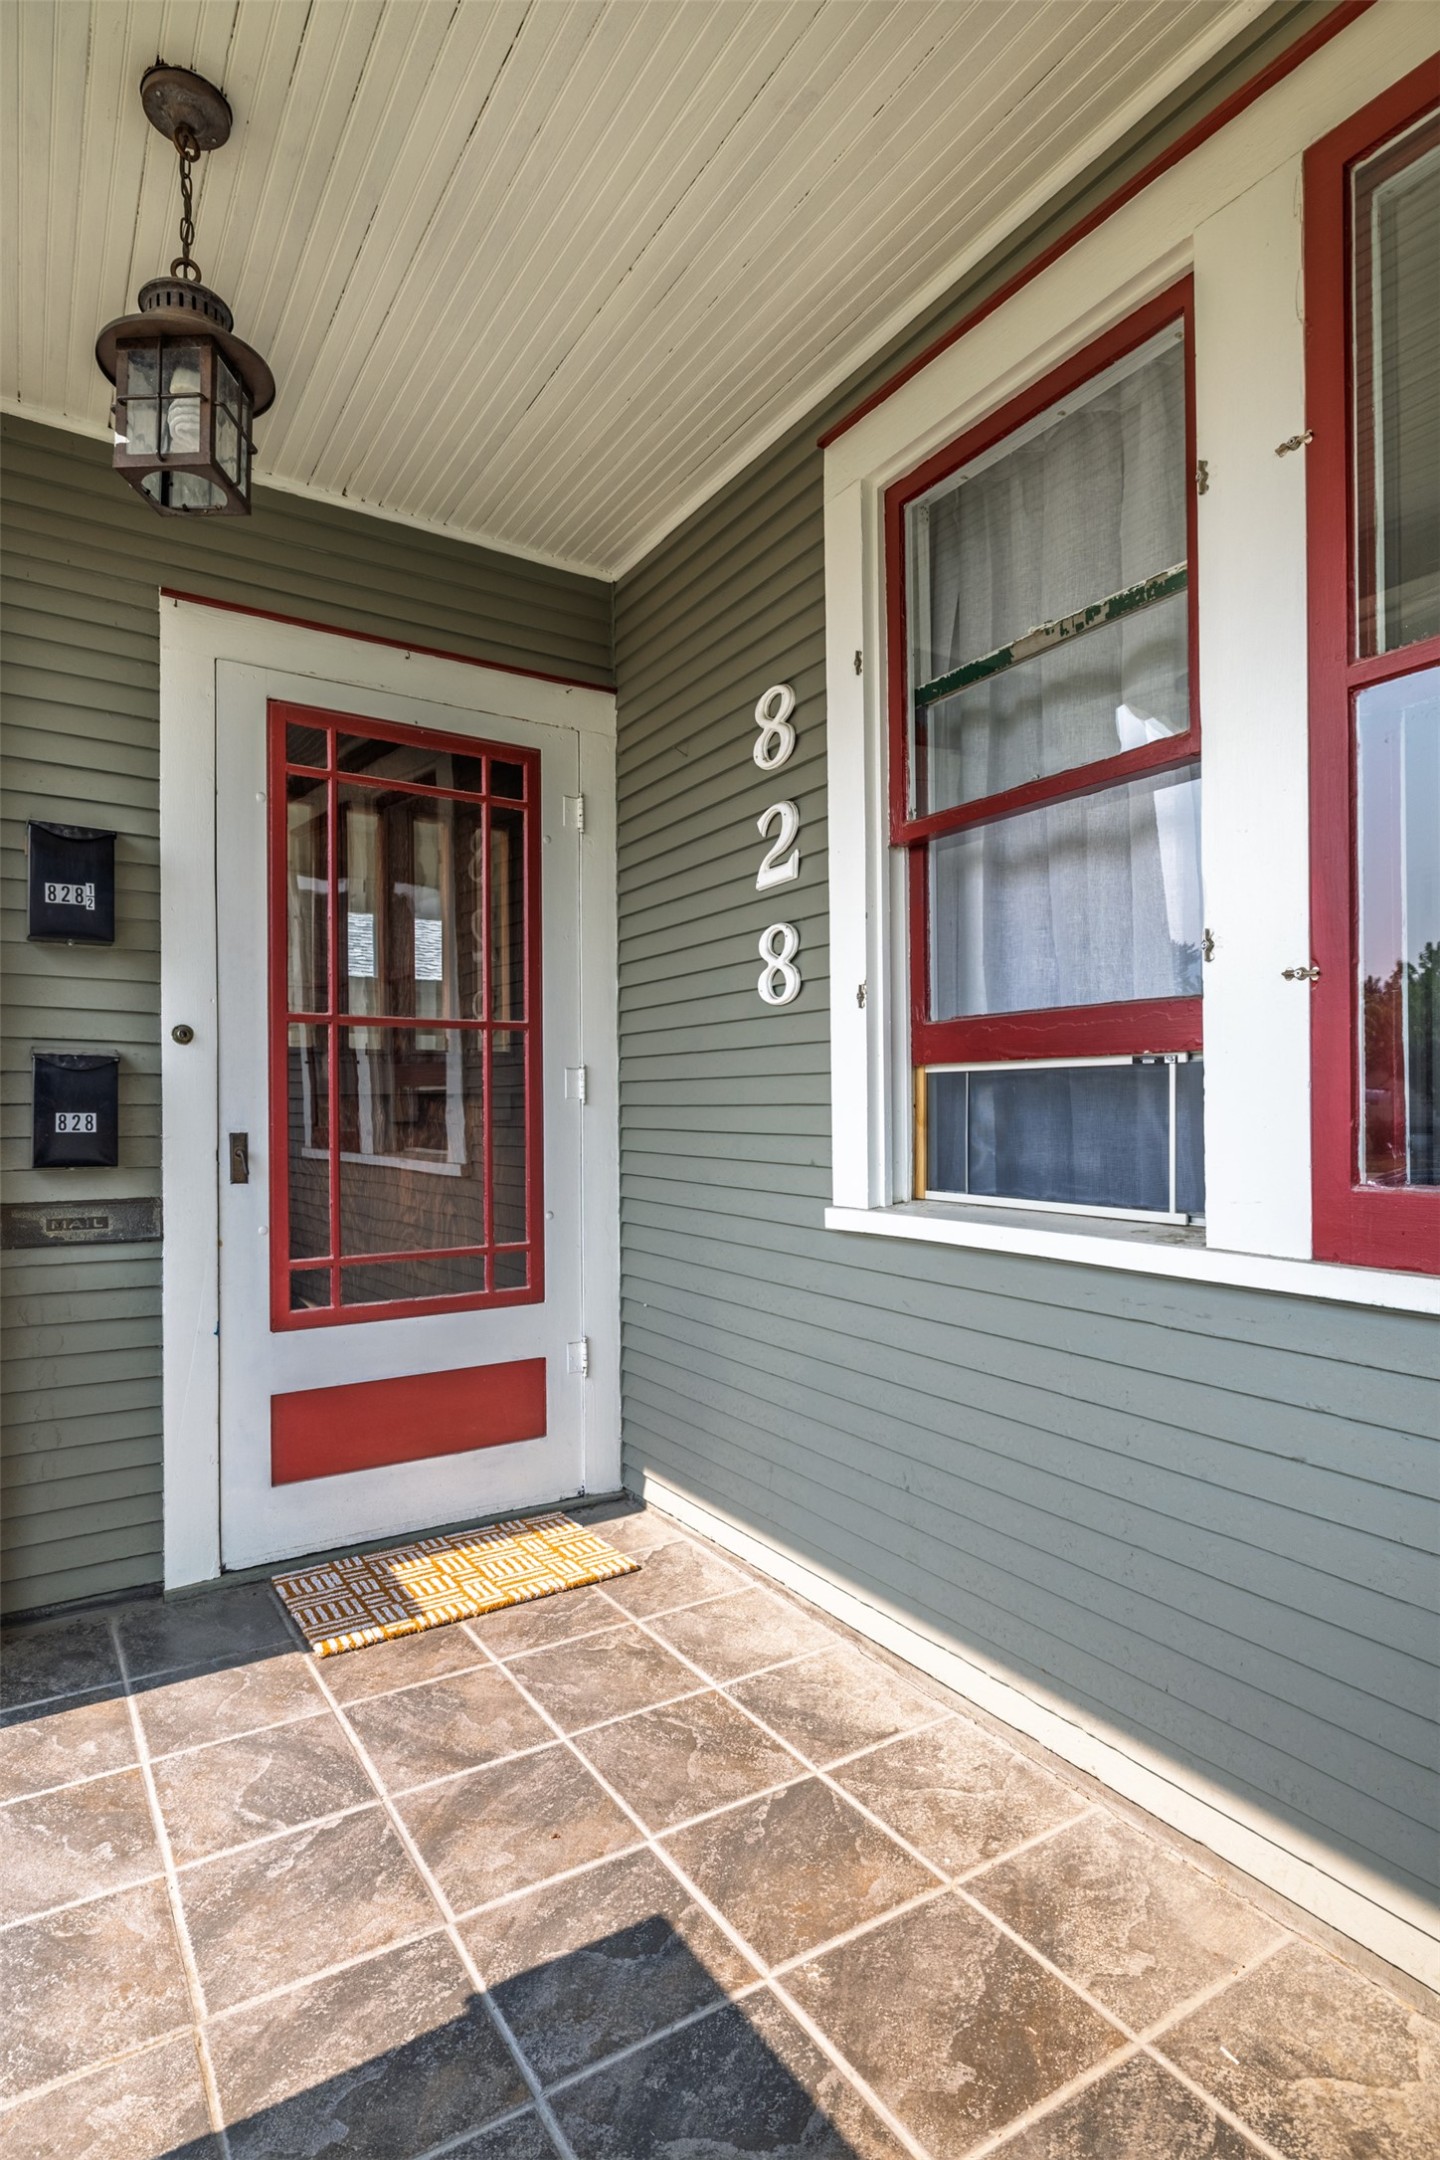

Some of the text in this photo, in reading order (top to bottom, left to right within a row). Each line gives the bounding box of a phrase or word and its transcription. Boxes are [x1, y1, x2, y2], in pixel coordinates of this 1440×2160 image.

[753, 684, 800, 1006] 828
[58, 1114, 94, 1131] 828
[51, 1218, 104, 1230] MAIL
